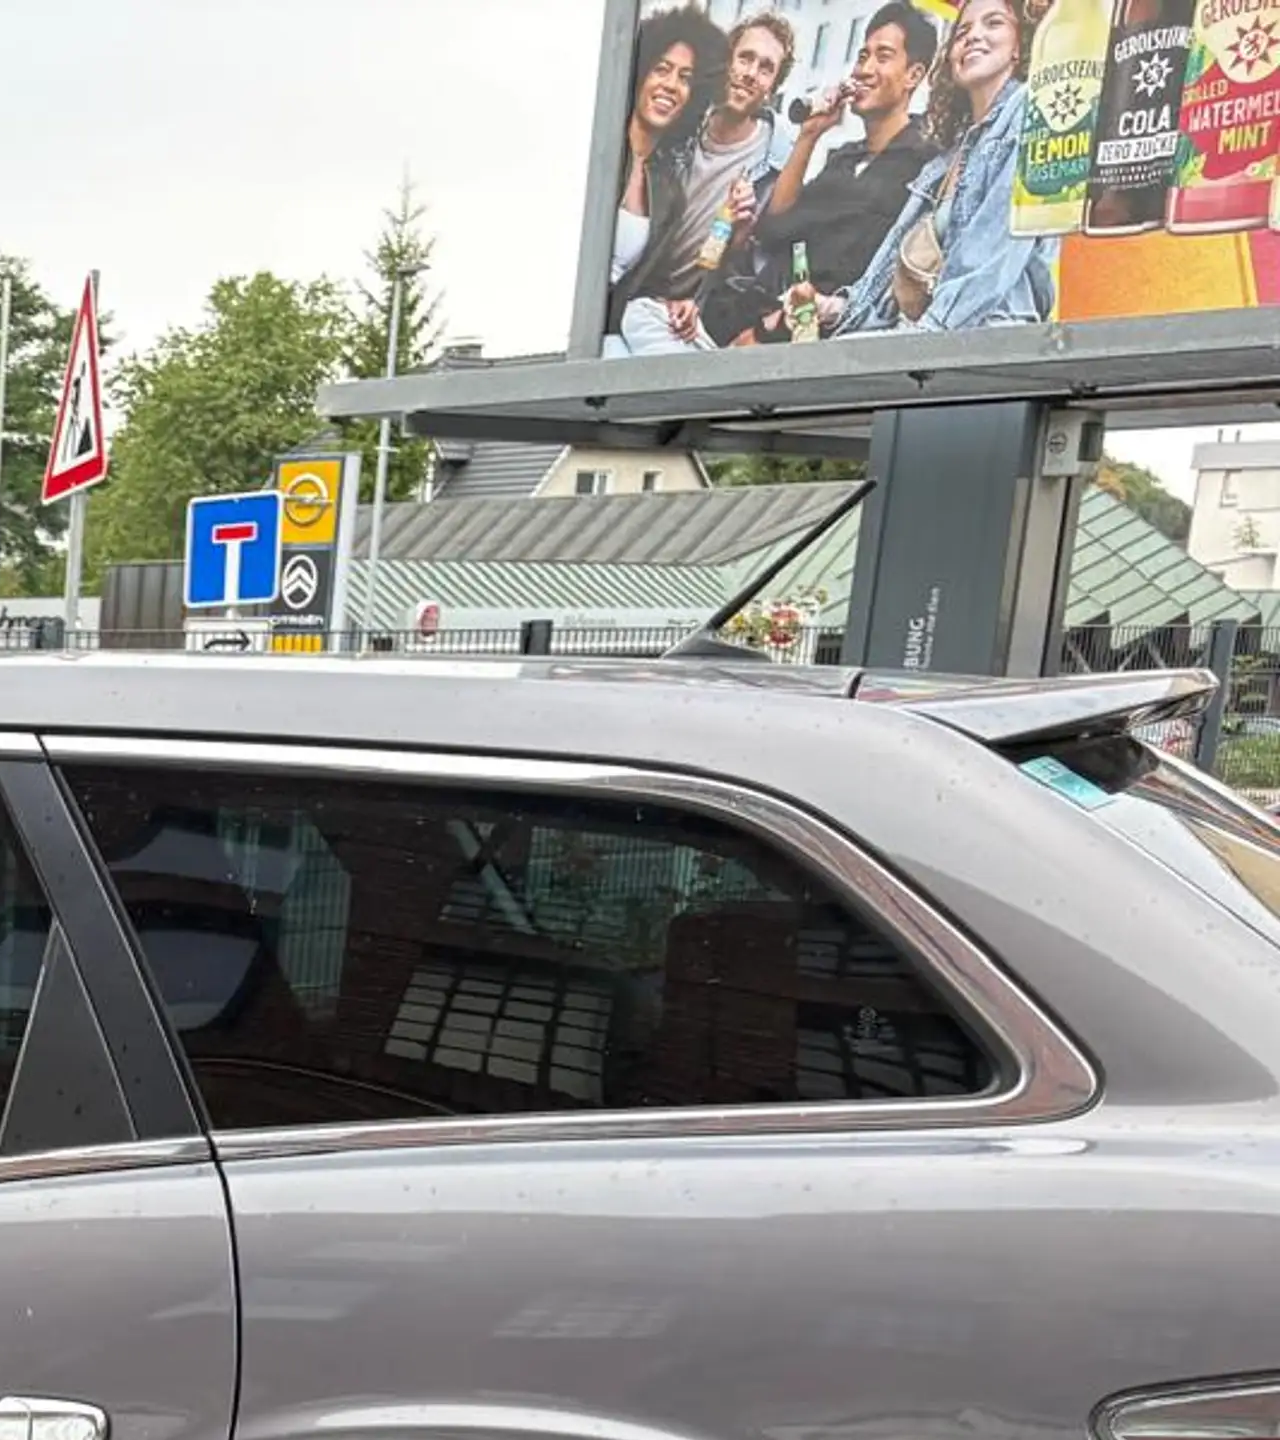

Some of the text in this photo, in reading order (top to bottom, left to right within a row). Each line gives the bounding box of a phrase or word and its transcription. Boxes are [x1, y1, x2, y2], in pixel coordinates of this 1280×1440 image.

[1119, 104, 1170, 136] COLA
[1028, 131, 1091, 164] LEMON
[1218, 120, 1272, 155] MINT
[903, 617, 925, 673] BUNG
